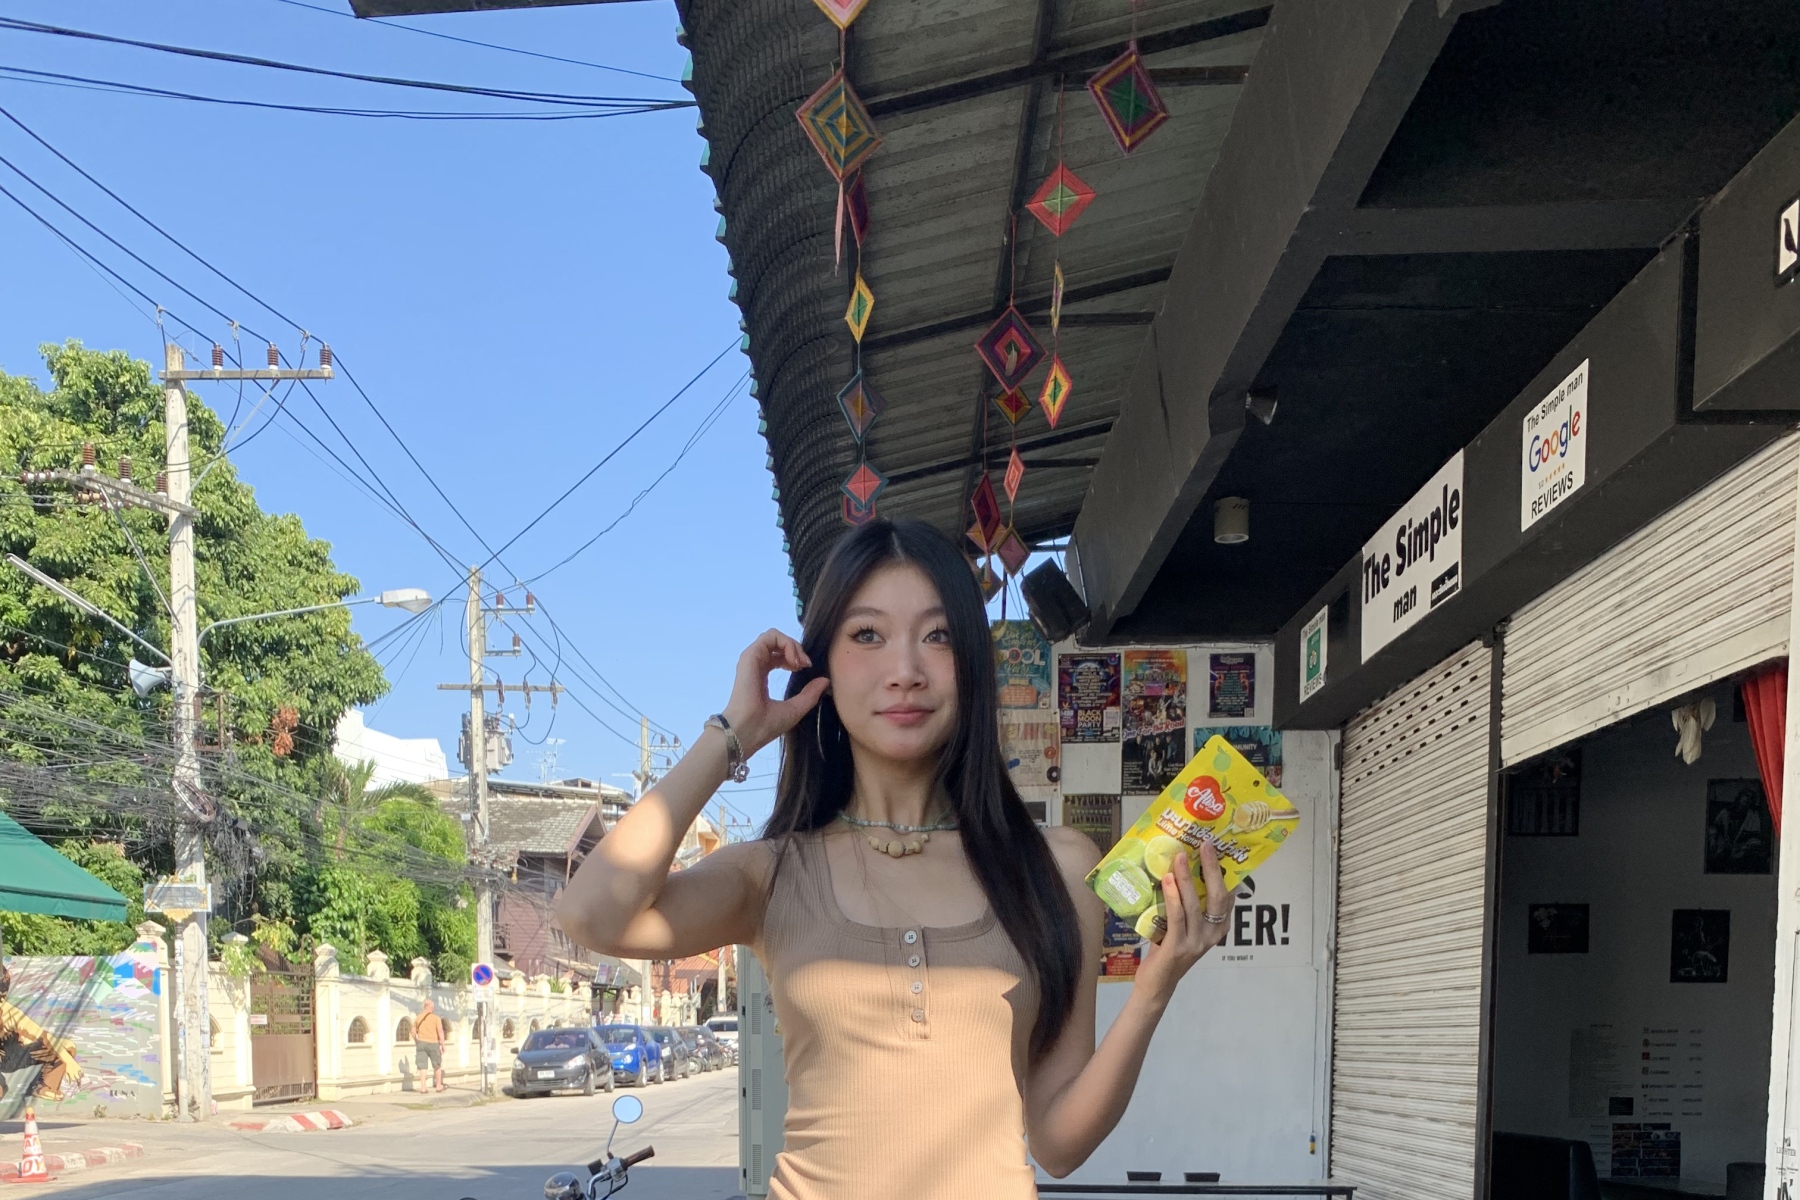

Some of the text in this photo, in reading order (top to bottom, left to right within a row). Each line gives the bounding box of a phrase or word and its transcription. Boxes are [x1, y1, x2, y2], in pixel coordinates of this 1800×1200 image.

[1527, 372, 1583, 433] The Simple man
[1528, 404, 1581, 473] Google
[1531, 470, 1574, 520] REVIEWS
[1363, 483, 1460, 605] The Simple
[1393, 584, 1417, 623] man
[1187, 786, 1224, 813] Alisa
[1156, 818, 1201, 850] Lime Honey
[1217, 903, 1290, 947] ER!
